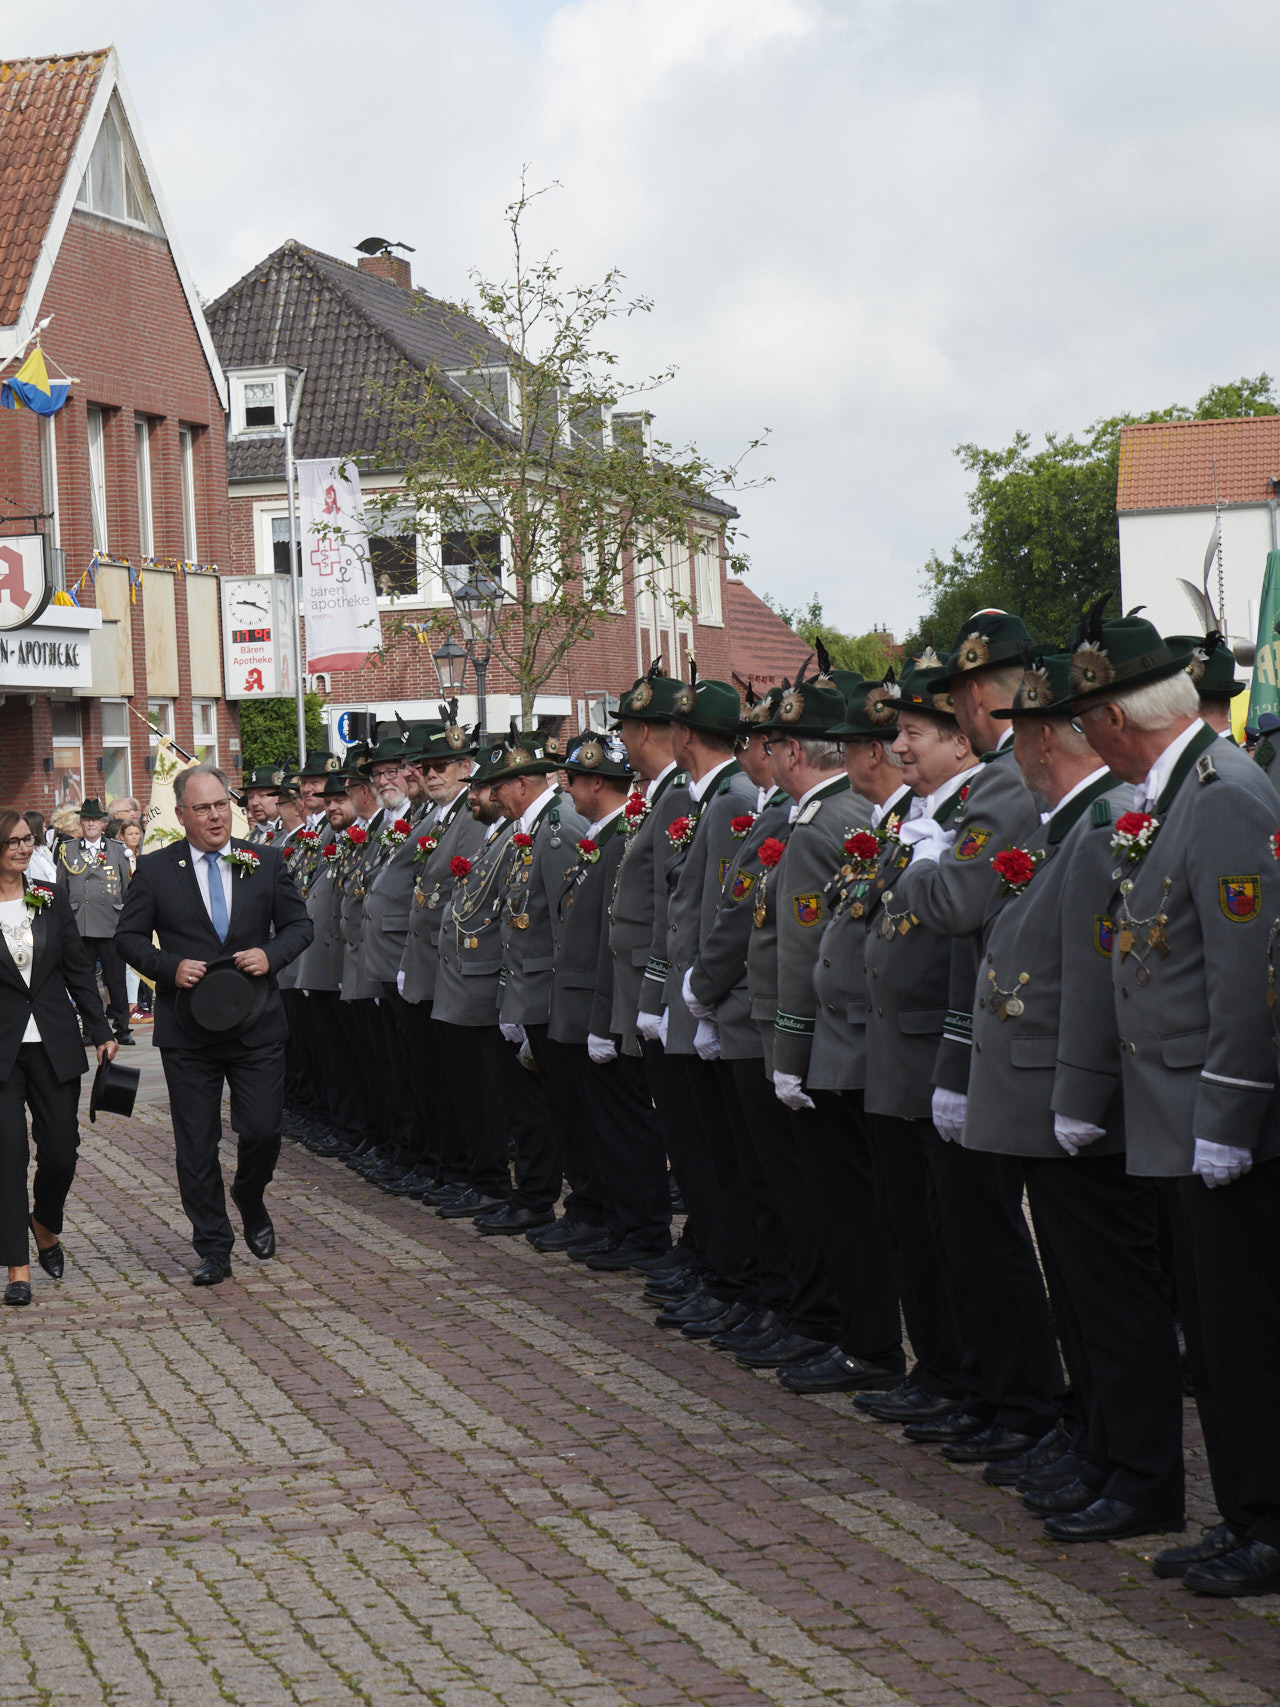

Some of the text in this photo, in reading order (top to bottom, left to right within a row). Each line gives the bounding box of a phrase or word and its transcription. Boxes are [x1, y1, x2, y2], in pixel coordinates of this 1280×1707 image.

[310, 585, 345, 598] bären
[311, 594, 371, 612] apotheke
[236, 629, 250, 643] 17
[240, 645, 265, 655] Bären
[233, 655, 273, 667] Apotheke
